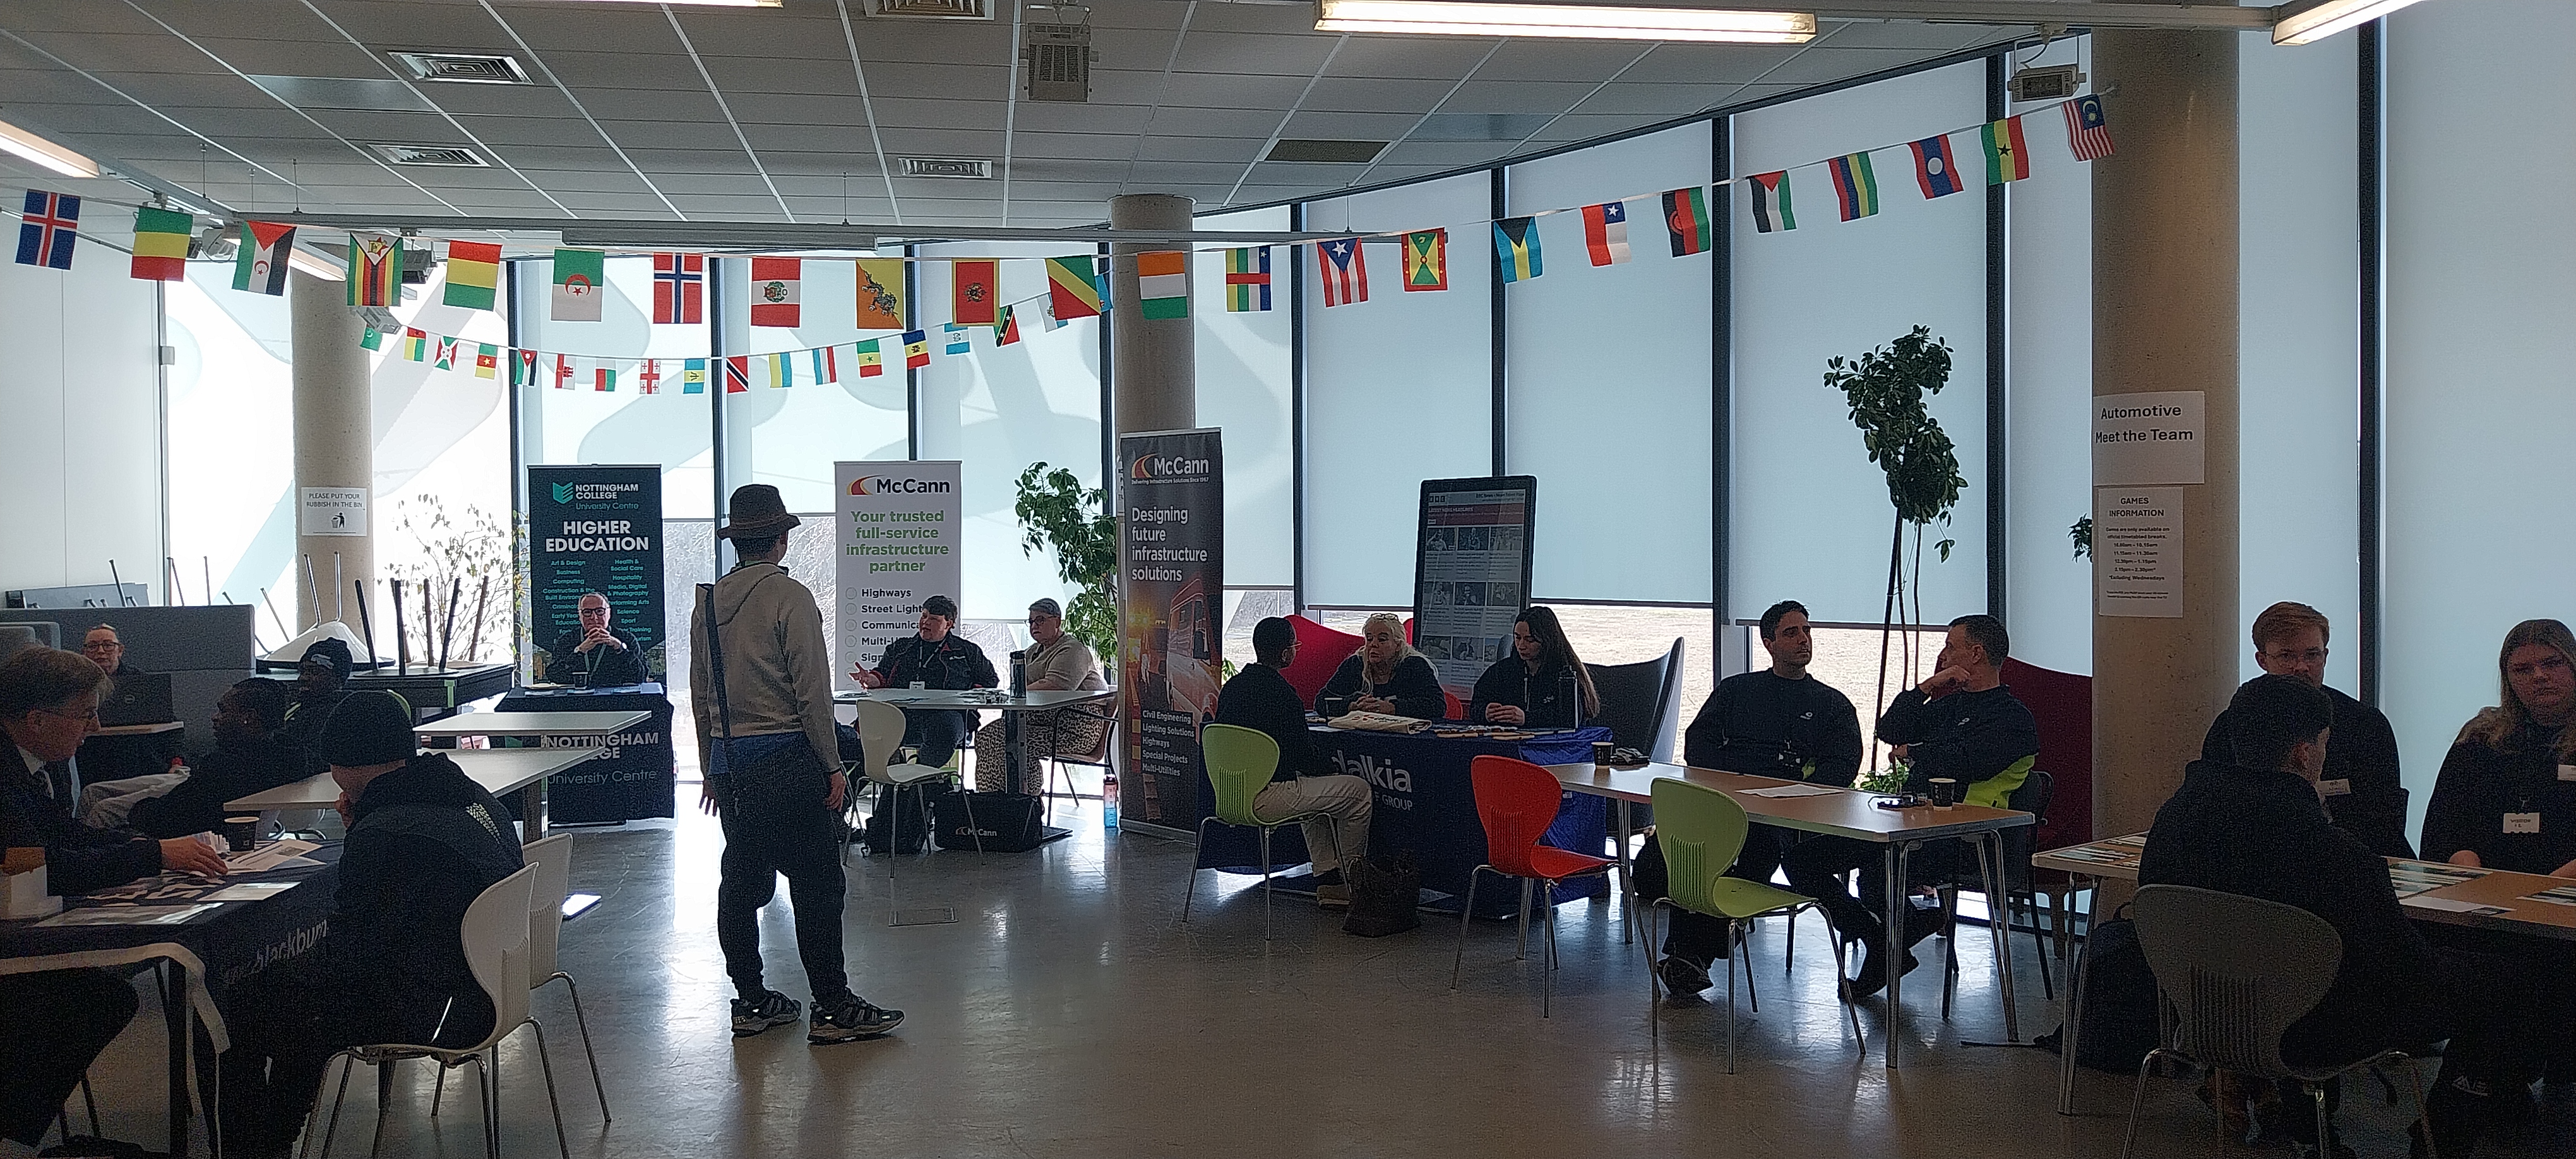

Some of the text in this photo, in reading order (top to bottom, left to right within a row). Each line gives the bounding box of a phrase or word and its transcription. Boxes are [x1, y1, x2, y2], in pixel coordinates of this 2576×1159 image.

[2101, 405, 2181, 419] Automotive
[2096, 429, 2193, 443] Meet the Team
[1154, 456, 1209, 475] McCann
[575, 484, 638, 492] NOTTINGHAM
[876, 478, 950, 494] McCann
[850, 510, 944, 522] Your trusted
[1132, 506, 1188, 524] Designing
[563, 521, 631, 535] HIGHER
[856, 527, 939, 538] full-service
[1132, 527, 1166, 542] future
[546, 537, 648, 552] EDUCATION
[845, 544, 949, 556] infrastructure
[1132, 547, 1208, 562] infrastructure
[869, 561, 926, 574] partner
[1131, 566, 1182, 581] solutions
[861, 588, 912, 598] Highways
[1143, 710, 1191, 724] Civil Engineering
[1143, 723, 1195, 737] Lighting Solutions
[547, 733, 659, 747] NOTTINGHAM
[1143, 737, 1170, 749] Highways
[1143, 750, 1188, 763] Special Projects
[612, 770, 657, 782] Centre
[1143, 764, 1180, 776] Multi-Utilities
[1382, 795, 1412, 811] GROUP
[968, 828, 997, 836] MCann
